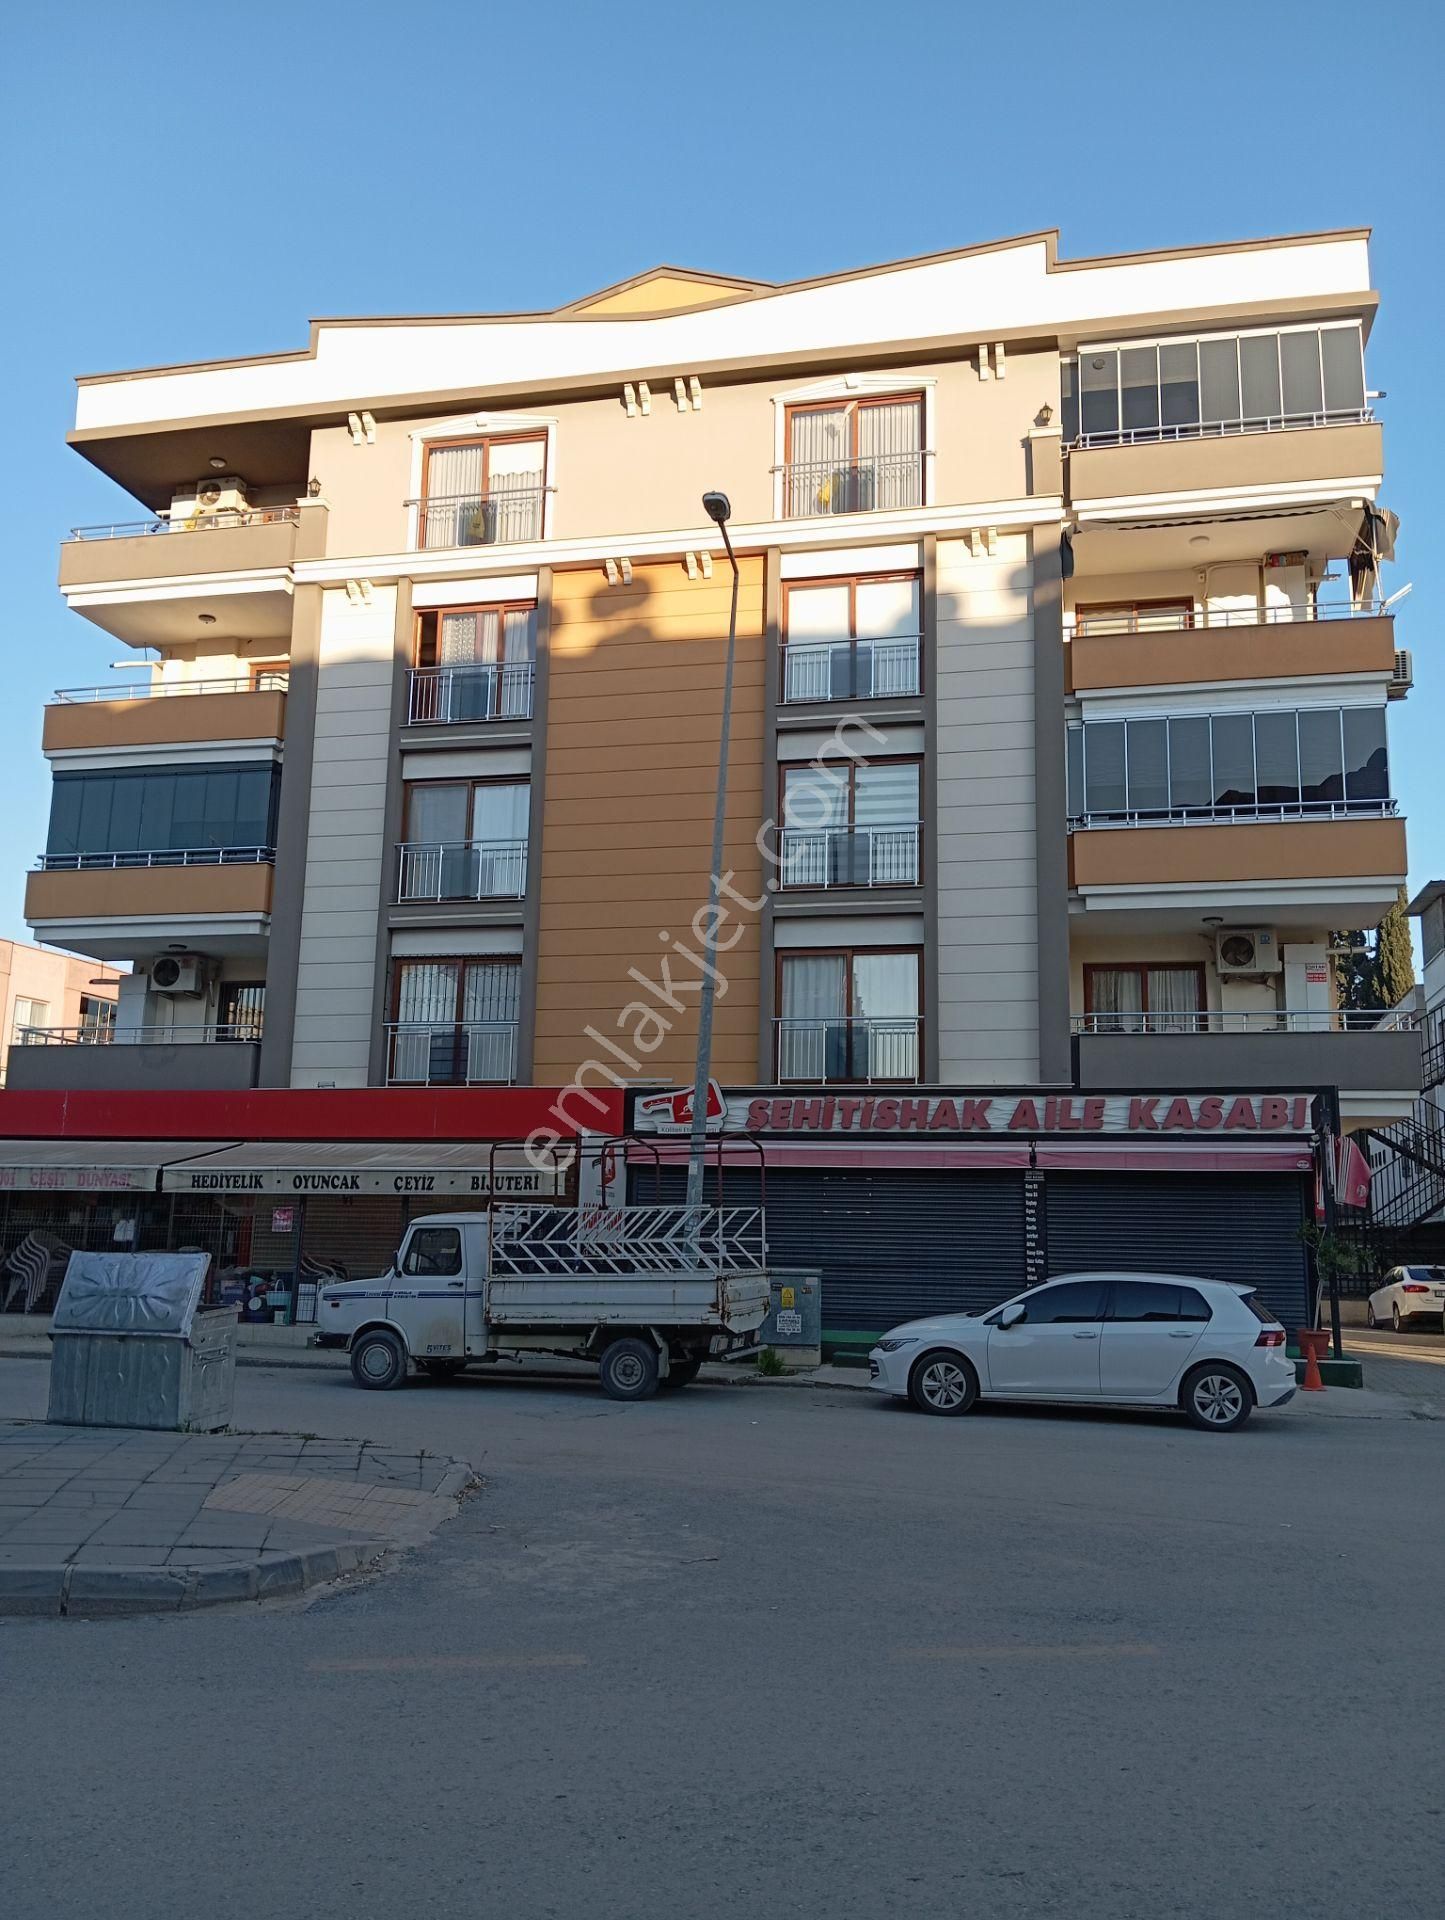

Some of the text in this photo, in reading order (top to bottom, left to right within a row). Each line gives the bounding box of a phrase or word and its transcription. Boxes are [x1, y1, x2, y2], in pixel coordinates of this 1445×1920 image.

[1007, 1096, 1106, 1130] AİLE
[1127, 1097, 1308, 1130] KASABI
[191, 1172, 264, 1189] HEDİYELİK
[293, 1174, 360, 1190] OYUNCAK
[393, 1174, 435, 1192] ÇEYİZ
